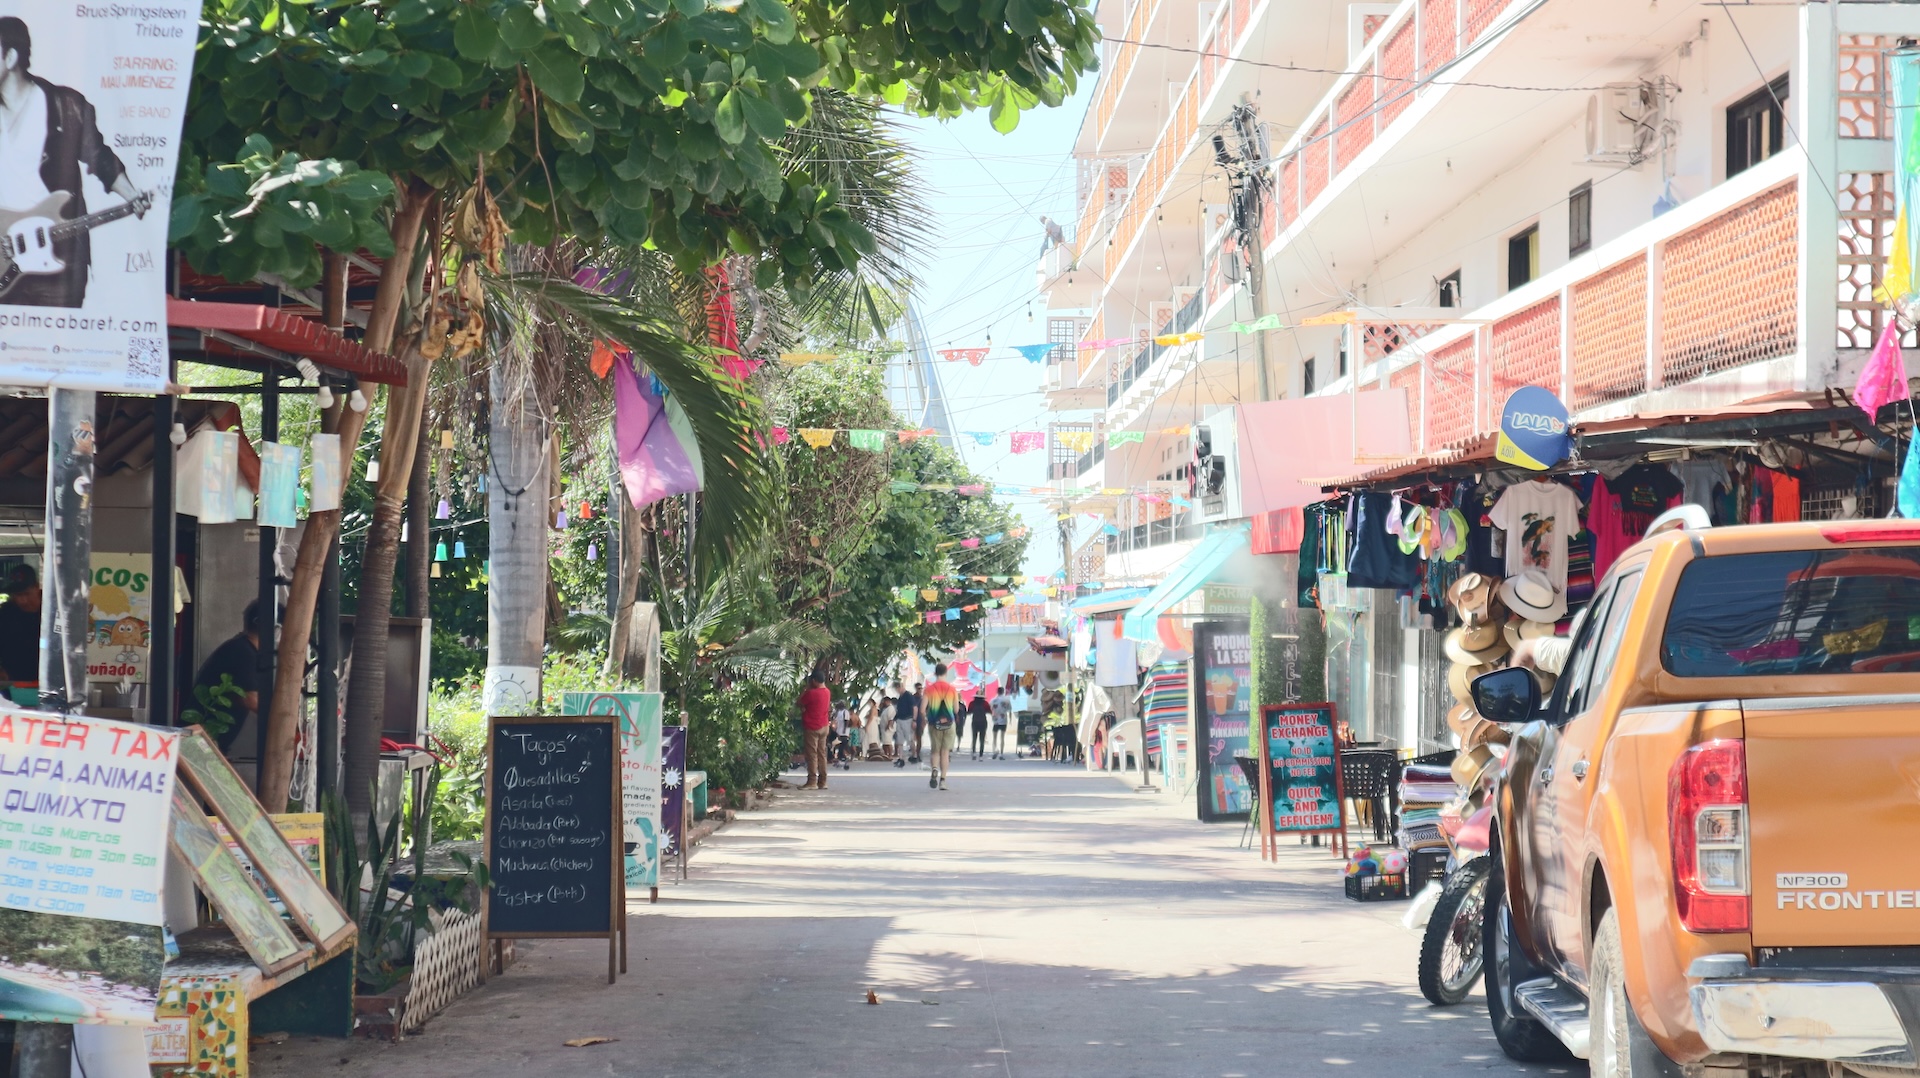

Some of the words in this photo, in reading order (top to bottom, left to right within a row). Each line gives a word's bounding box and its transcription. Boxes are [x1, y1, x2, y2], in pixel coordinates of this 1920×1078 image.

[109, 3, 187, 21] Springsteen
[135, 23, 183, 38] Tribute
[113, 56, 178, 72] STARRING:
[122, 73, 176, 90] JIMÉNEZ
[138, 106, 171, 120] BAND
[114, 133, 167, 151] Saturdays
[137, 154, 164, 172] 5pm
[0, 312, 157, 333] palmcabaret.com
[1512, 412, 1553, 432] LALA
[1217, 650, 1231, 665] LA
[86, 662, 136, 677] uñado
[1279, 713, 1318, 726] MONEY
[1271, 726, 1328, 739] EXCHANGE
[109, 727, 177, 762] TAX
[1291, 747, 1304, 755] NO
[1273, 759, 1285, 767] NO
[1286, 757, 1331, 767] COMMISSION
[1290, 769, 1302, 777] NO
[1303, 768, 1316, 776] FEE
[630, 785, 655, 793] flavors
[1287, 786, 1322, 800] QUICK
[501, 794, 543, 812] Asada
[623, 793, 651, 801] made
[4, 789, 126, 824] QUIMIXTO
[1294, 801, 1318, 813] AND
[499, 815, 551, 832] Adobada
[1280, 814, 1334, 827] EFFICIENT
[31, 823, 54, 837] Los
[60, 827, 121, 844] Muertos
[499, 835, 546, 849] Chorizo
[70, 846, 92, 860] 1pm
[98, 850, 126, 864] 3pm
[46, 862, 95, 878] Yelapa
[1783, 875, 1841, 886] NP300
[96, 885, 124, 899] 11am
